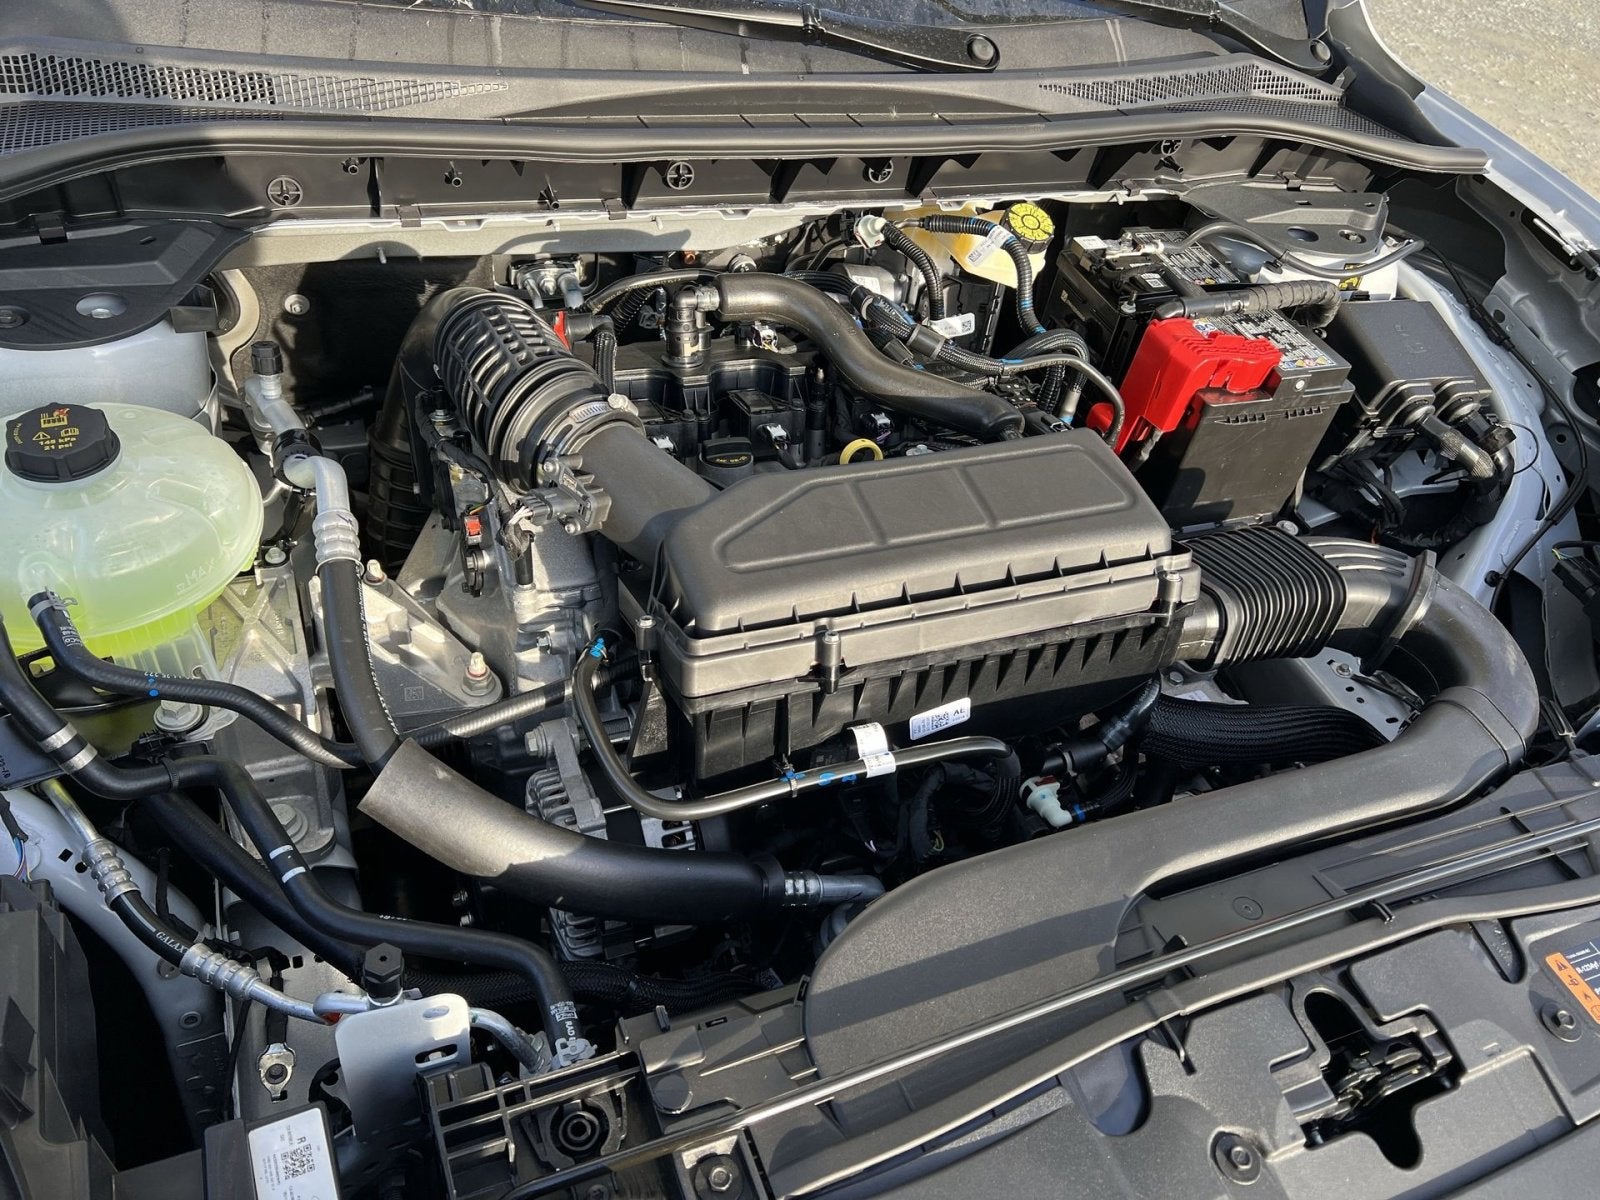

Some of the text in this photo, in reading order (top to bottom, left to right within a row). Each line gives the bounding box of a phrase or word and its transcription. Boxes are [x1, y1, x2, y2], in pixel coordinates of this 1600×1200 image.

[184, 558, 216, 583] MAX
[565, 1020, 575, 1036] RAD
[297, 1136, 306, 1144] R
